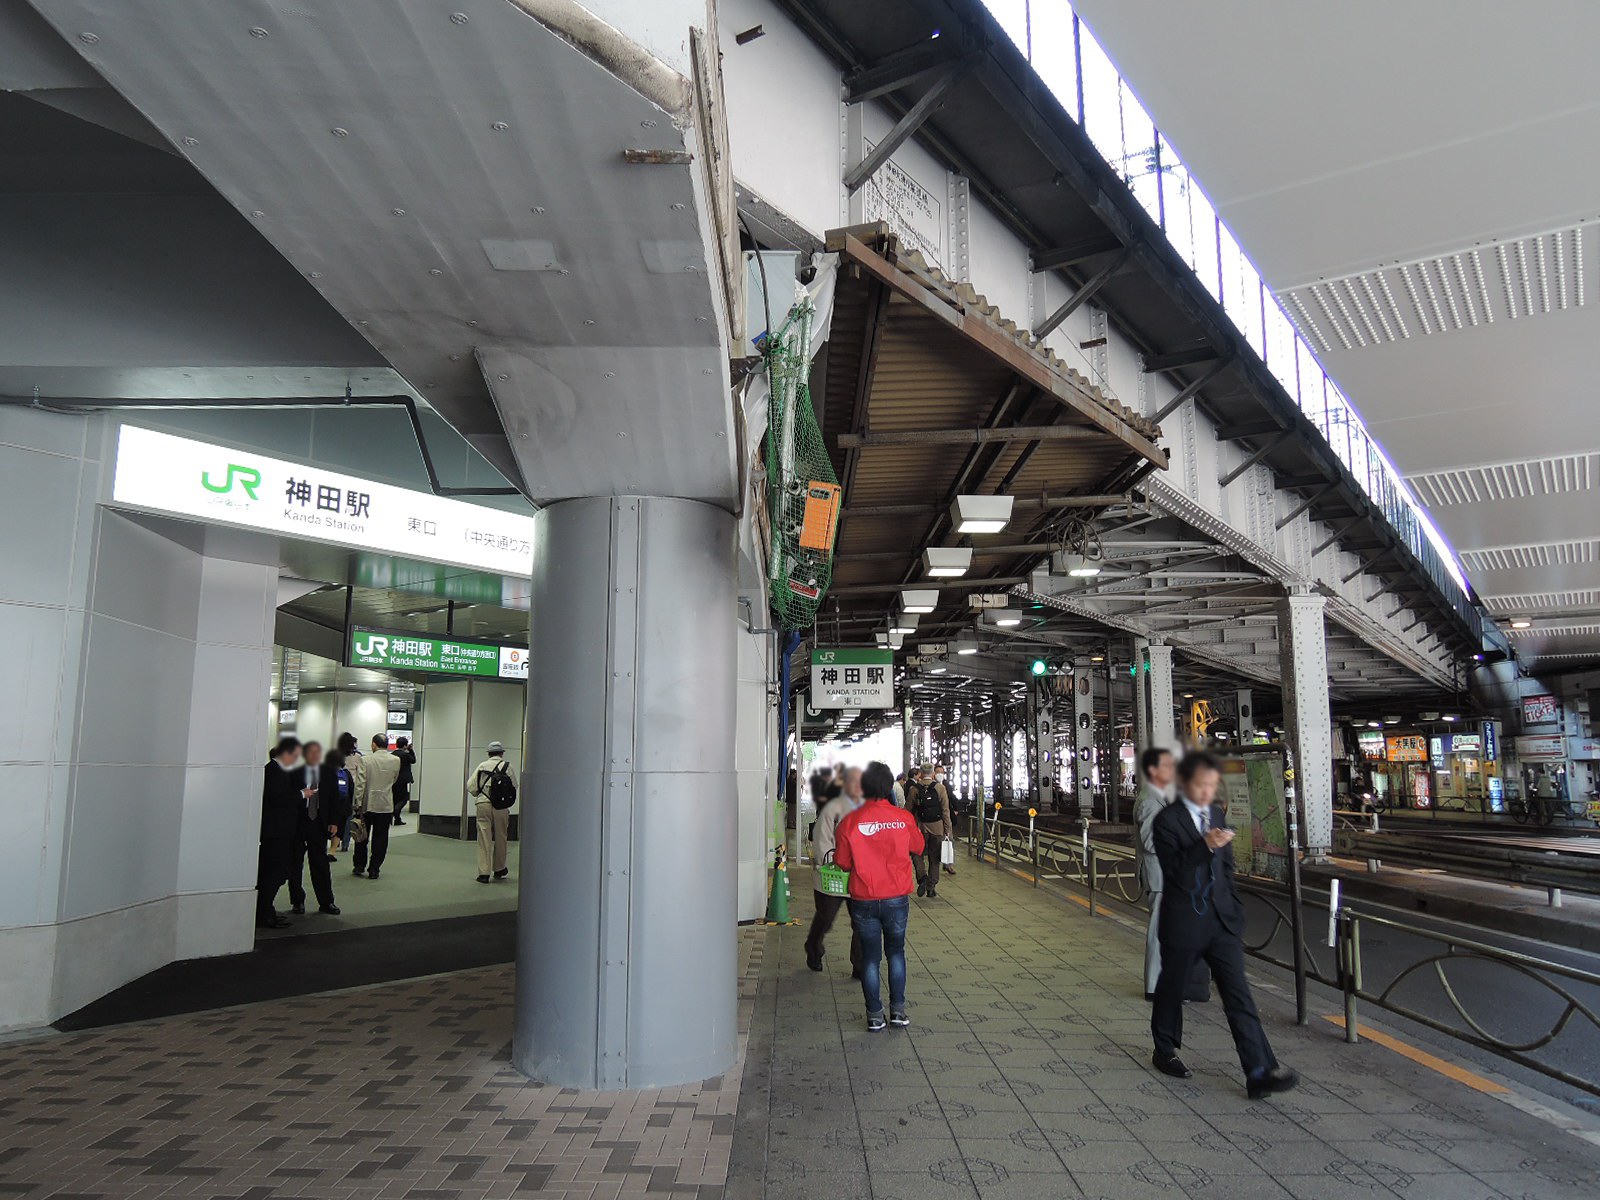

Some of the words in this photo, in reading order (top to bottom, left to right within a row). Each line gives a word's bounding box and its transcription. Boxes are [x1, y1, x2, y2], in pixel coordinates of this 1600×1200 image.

[201, 463, 261, 501] JR
[284, 476, 371, 519] 神田駅
[284, 508, 322, 526] Kanda
[325, 515, 365, 533] Station
[407, 516, 438, 537] 東口
[356, 635, 388, 657] JR
[391, 638, 432, 657] 神田駅
[820, 652, 835, 660] JR
[390, 656, 414, 667] Kanda
[415, 657, 438, 668] Station
[820, 667, 884, 685] 神田駅
[844, 697, 861, 705] 東口
